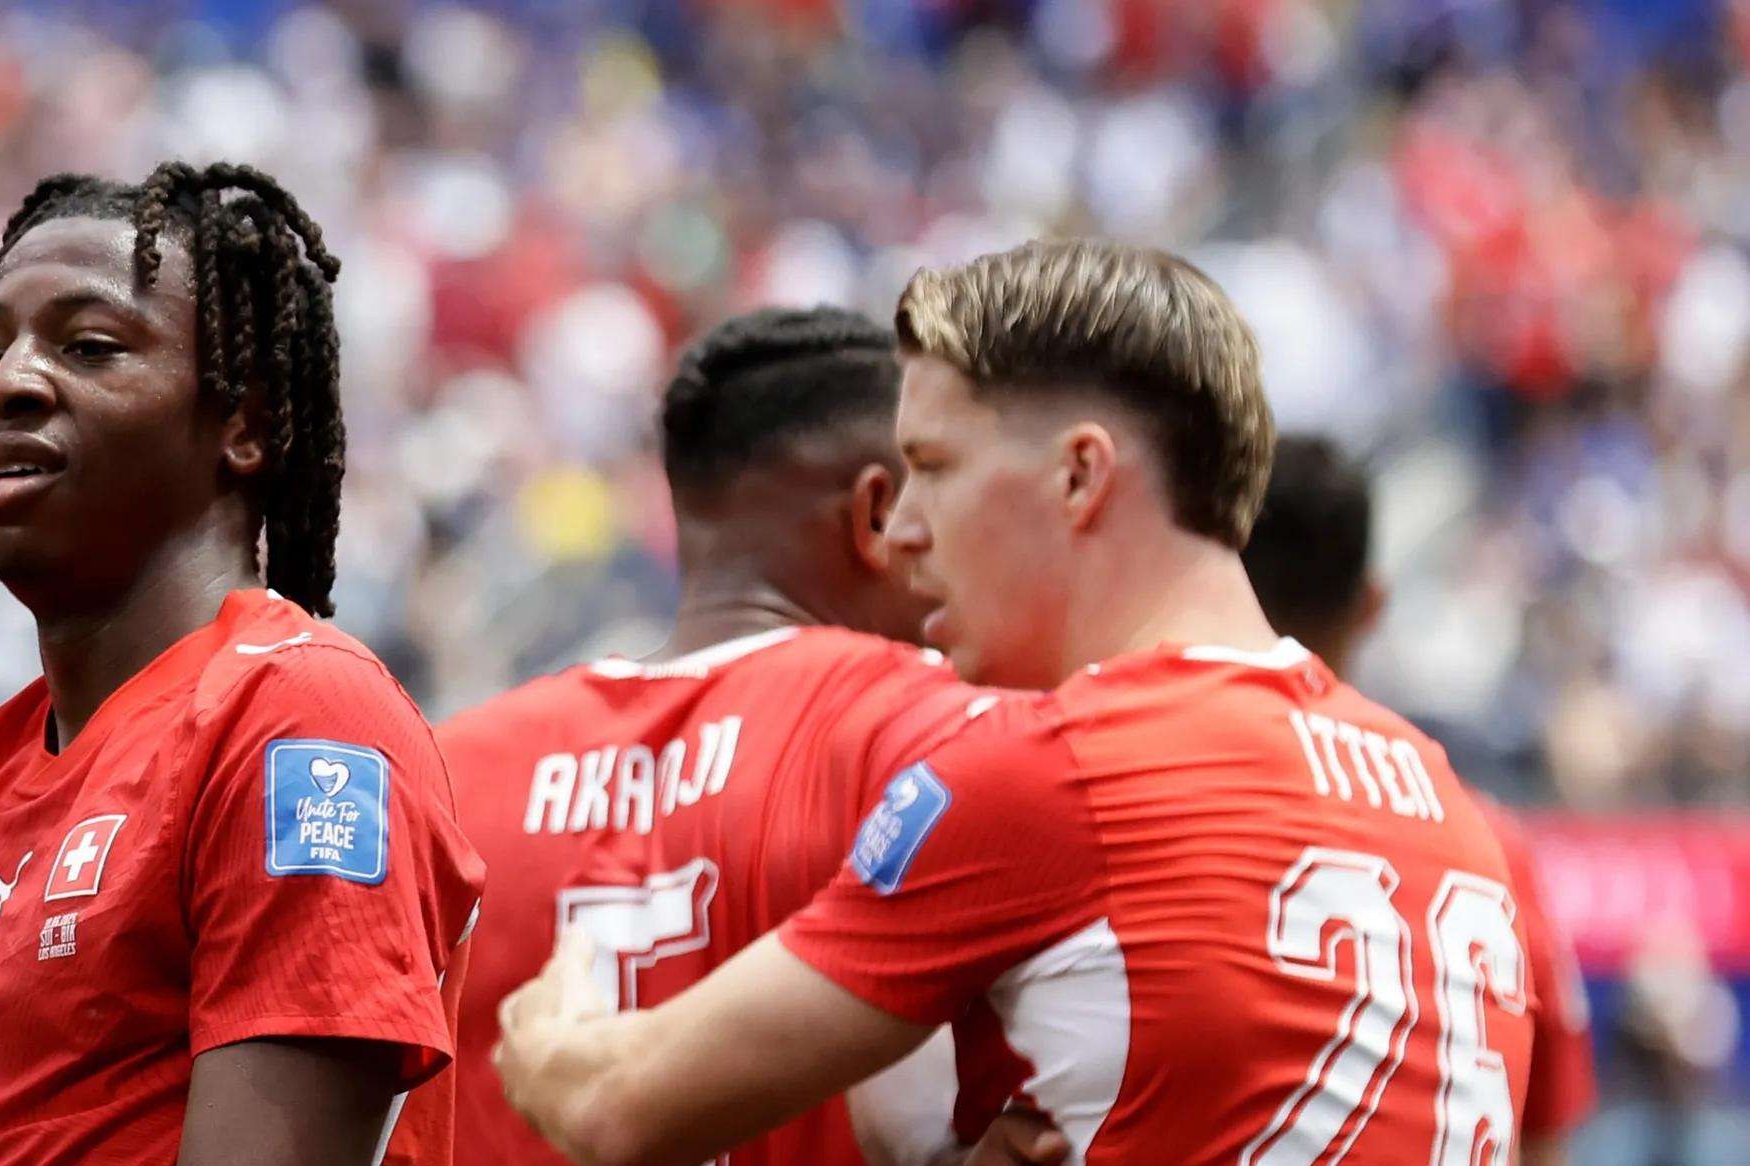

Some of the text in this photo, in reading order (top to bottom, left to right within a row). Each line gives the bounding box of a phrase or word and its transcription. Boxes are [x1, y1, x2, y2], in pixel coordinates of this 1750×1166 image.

[523, 714, 743, 835] AKANJI
[1288, 709, 1444, 823] ITTEN
[296, 797, 361, 824] Unite For
[300, 822, 354, 849] PEACE
[310, 847, 342, 861] FIFA
